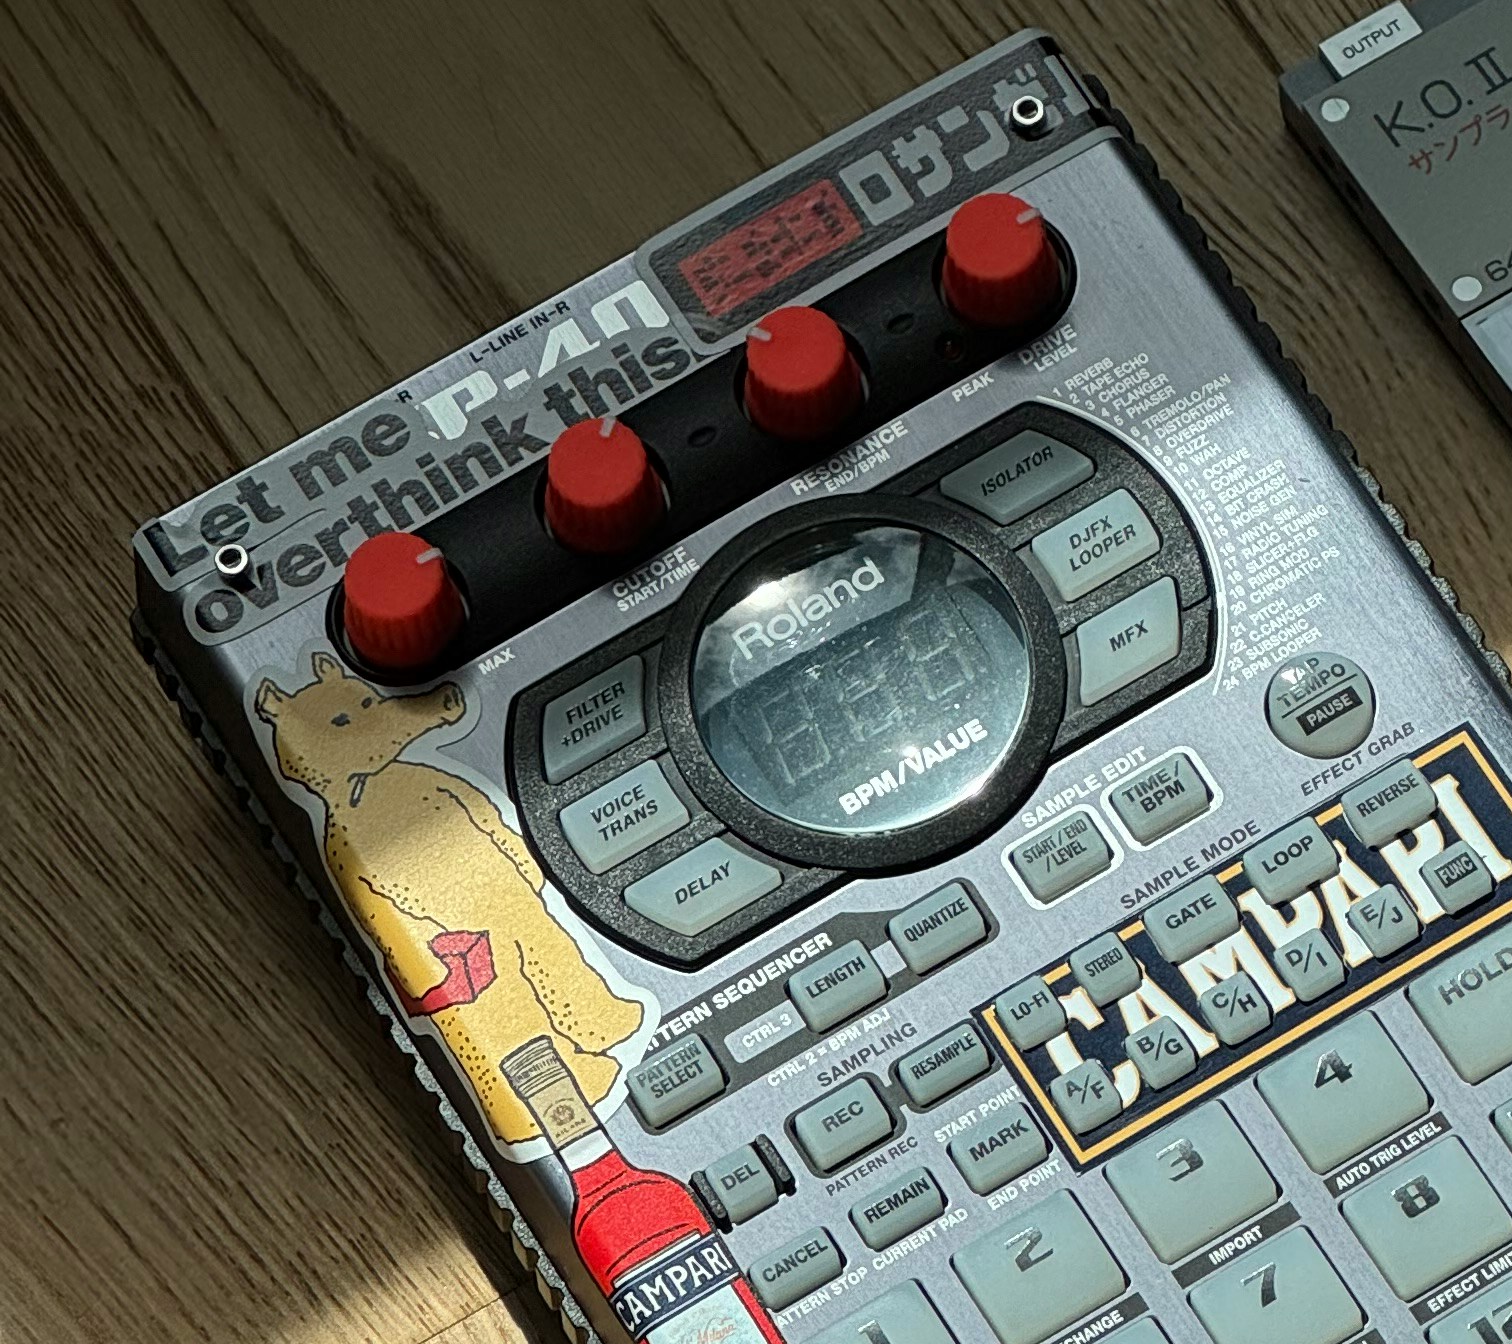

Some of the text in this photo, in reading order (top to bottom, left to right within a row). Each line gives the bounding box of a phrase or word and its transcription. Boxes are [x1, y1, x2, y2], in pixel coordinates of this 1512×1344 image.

[1339, 17, 1405, 61] OUTPUT
[1372, 70, 1475, 148] K.O.
[468, 299, 571, 363] L-LINE IN-R
[1016, 322, 1078, 365] DRIVE
[1032, 340, 1079, 373] LEVEL
[1063, 356, 1115, 390] REVERB
[1069, 351, 1150, 403] 2 TAPE ECHO
[950, 371, 995, 402] PEAK
[1085, 366, 1151, 410] 3 CHORUS
[1111, 372, 1170, 411] FLANGER
[1125, 384, 1177, 419] PHASER
[1140, 373, 1232, 431] TREMOLO/PAN
[789, 419, 909, 495] RESONANCE
[823, 447, 892, 493] END/BPM
[977, 445, 1056, 496] ISOLATOR
[141, 406, 417, 579] Let me
[178, 399, 553, 641] overthink
[1066, 515, 1114, 549] DJFX
[1066, 522, 1139, 571] LOOPER
[609, 545, 690, 599] CUTOFF
[615, 557, 701, 613] START/TIME
[1248, 556, 1323, 605] CHROMATIC
[1320, 545, 1341, 562] PS
[729, 554, 886, 660] Roland
[1106, 620, 1149, 651] MFX
[1240, 656, 1272, 680] BPM
[1269, 626, 1323, 663] LOOPER
[477, 646, 516, 675] MAX
[564, 680, 627, 724] FILTER
[1275, 660, 1348, 710] TEMPO
[558, 703, 626, 750] +DRIVE
[1304, 691, 1355, 728] PAUSE
[837, 717, 990, 816] BPM/VALUE
[1299, 721, 1416, 797] EFFECT GRAB
[589, 783, 648, 824] VOICE
[1019, 745, 1150, 830] SAMPLE EDIT
[1355, 773, 1420, 818] REVERSE
[597, 798, 661, 842] TRANS
[1118, 818, 1262, 910] SAMPLE MODE
[1260, 833, 1318, 874] LOOP
[1437, 854, 1475, 884] FUNC
[672, 860, 735, 904] DELAY
[902, 896, 970, 943] QUANTIZE
[1163, 892, 1217, 931] GATE
[710, 930, 834, 1011] SEQUENCER
[805, 955, 867, 999] LENGTH
[1083, 946, 1124, 978] STEREO
[634, 1040, 703, 1088] PATTERN
[815, 1020, 918, 1088] SAMPLING
[909, 1032, 978, 1080] RESAMPLE
[1305, 1047, 1356, 1092] 4
[649, 1059, 706, 1100] SELECT
[820, 1098, 865, 1133] REC
[967, 1117, 1030, 1162] MARK
[1156, 1136, 1203, 1181] 3
[1333, 1118, 1443, 1191] AUTO TRIG LEVEL
[720, 1160, 760, 1191] DEL
[862, 1176, 930, 1224] REMAIN
[759, 1236, 828, 1284] CANCEL
[1005, 1225, 1053, 1270] 2
[1207, 1224, 1266, 1266] IMPORT
[612, 1239, 735, 1330] CAMPARI
